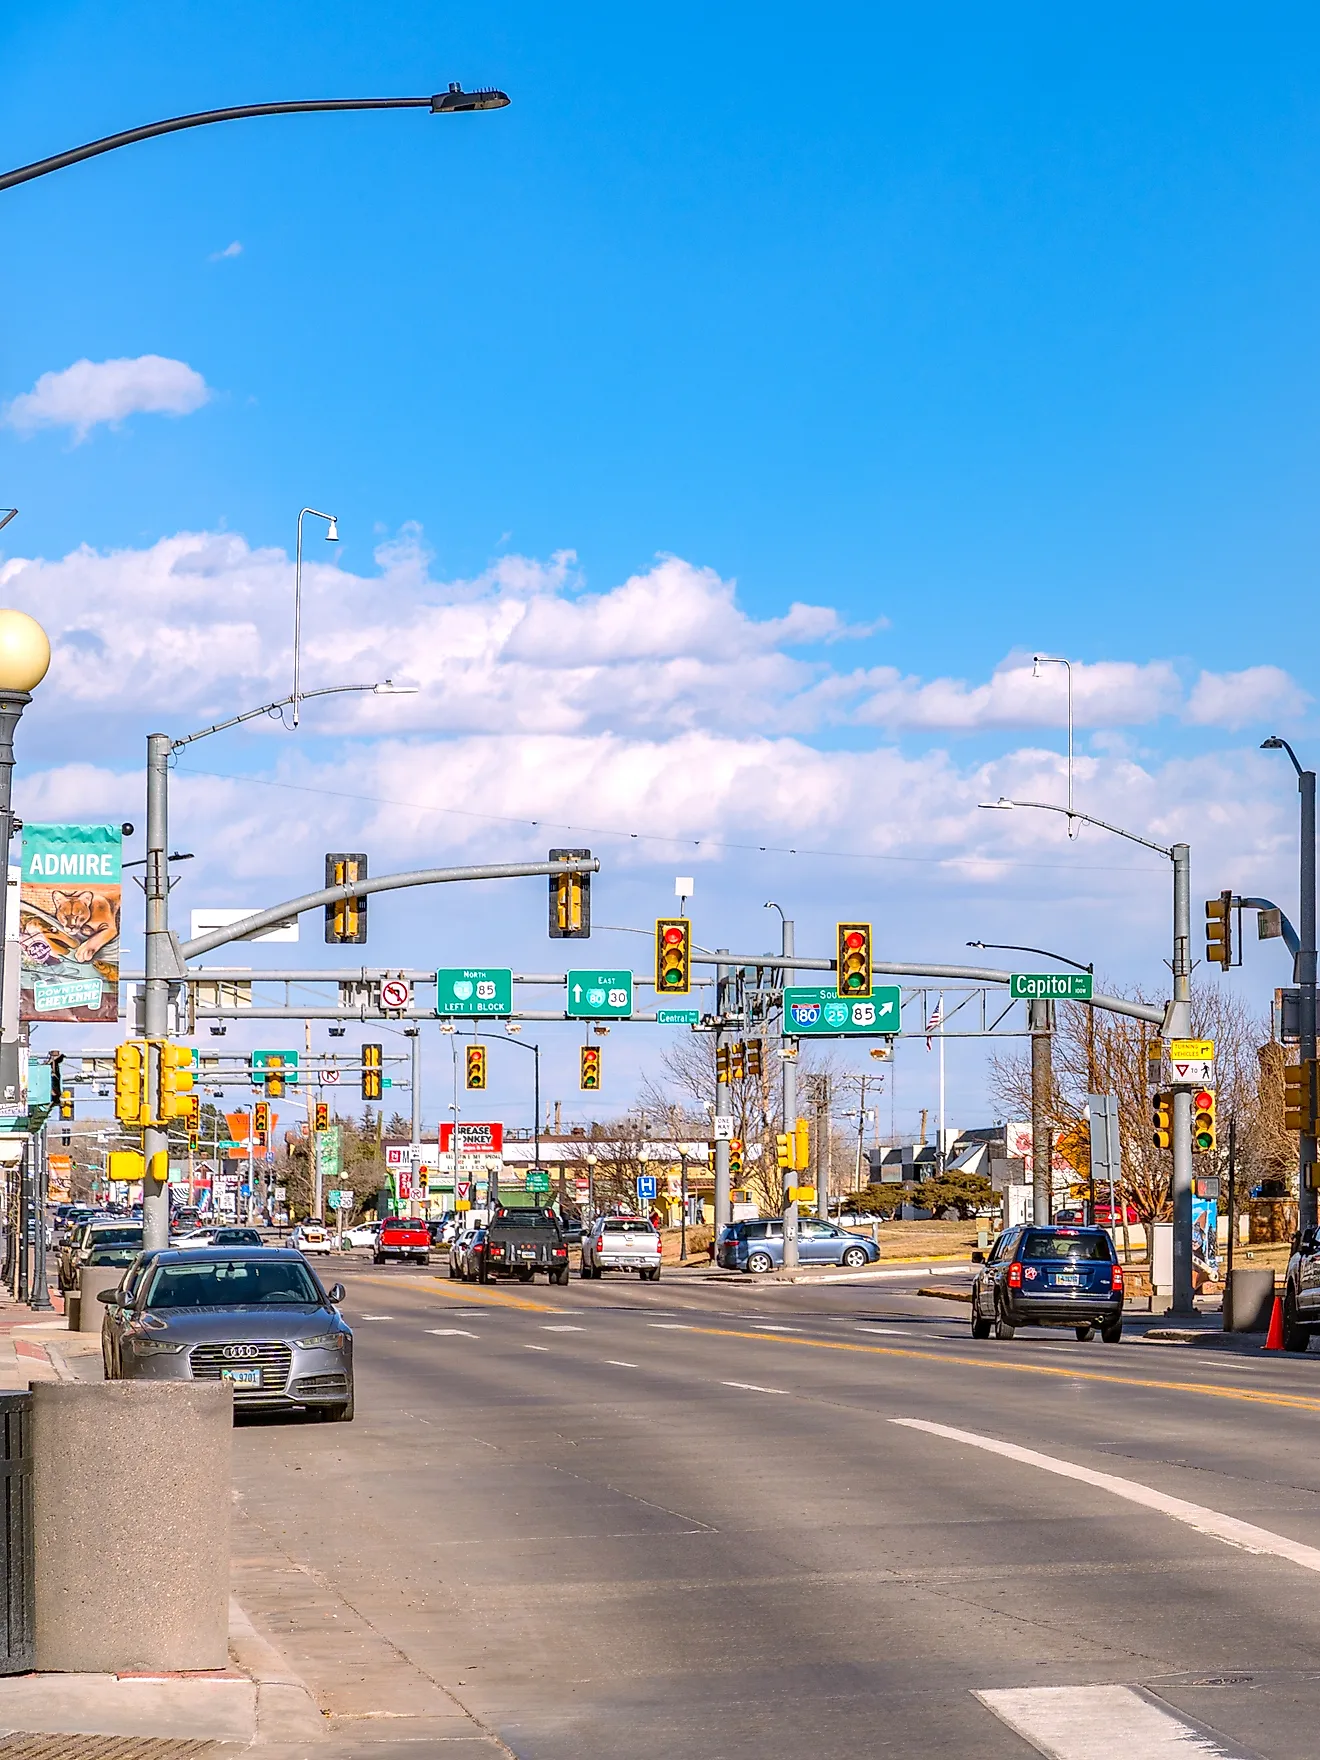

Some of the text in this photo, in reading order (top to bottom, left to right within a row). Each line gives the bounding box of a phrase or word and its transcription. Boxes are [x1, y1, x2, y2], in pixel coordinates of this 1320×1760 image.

[29, 853, 113, 876] ADMIRE
[463, 970, 487, 979] NORTH
[598, 976, 616, 985] EAST
[38, 982, 100, 997] DOWNTOWN
[478, 985, 494, 996] 85
[1016, 975, 1072, 998] Capitol
[37, 990, 100, 1009] CHEYENNE
[610, 992, 626, 1003] 30
[444, 1002, 465, 1011] LEFT
[477, 1002, 505, 1011] BLOCK
[659, 1011, 688, 1023] Central
[795, 1008, 873, 1023] 180 25 85
[641, 1178, 653, 1192] H
[239, 1373, 257, 1383] 9701
